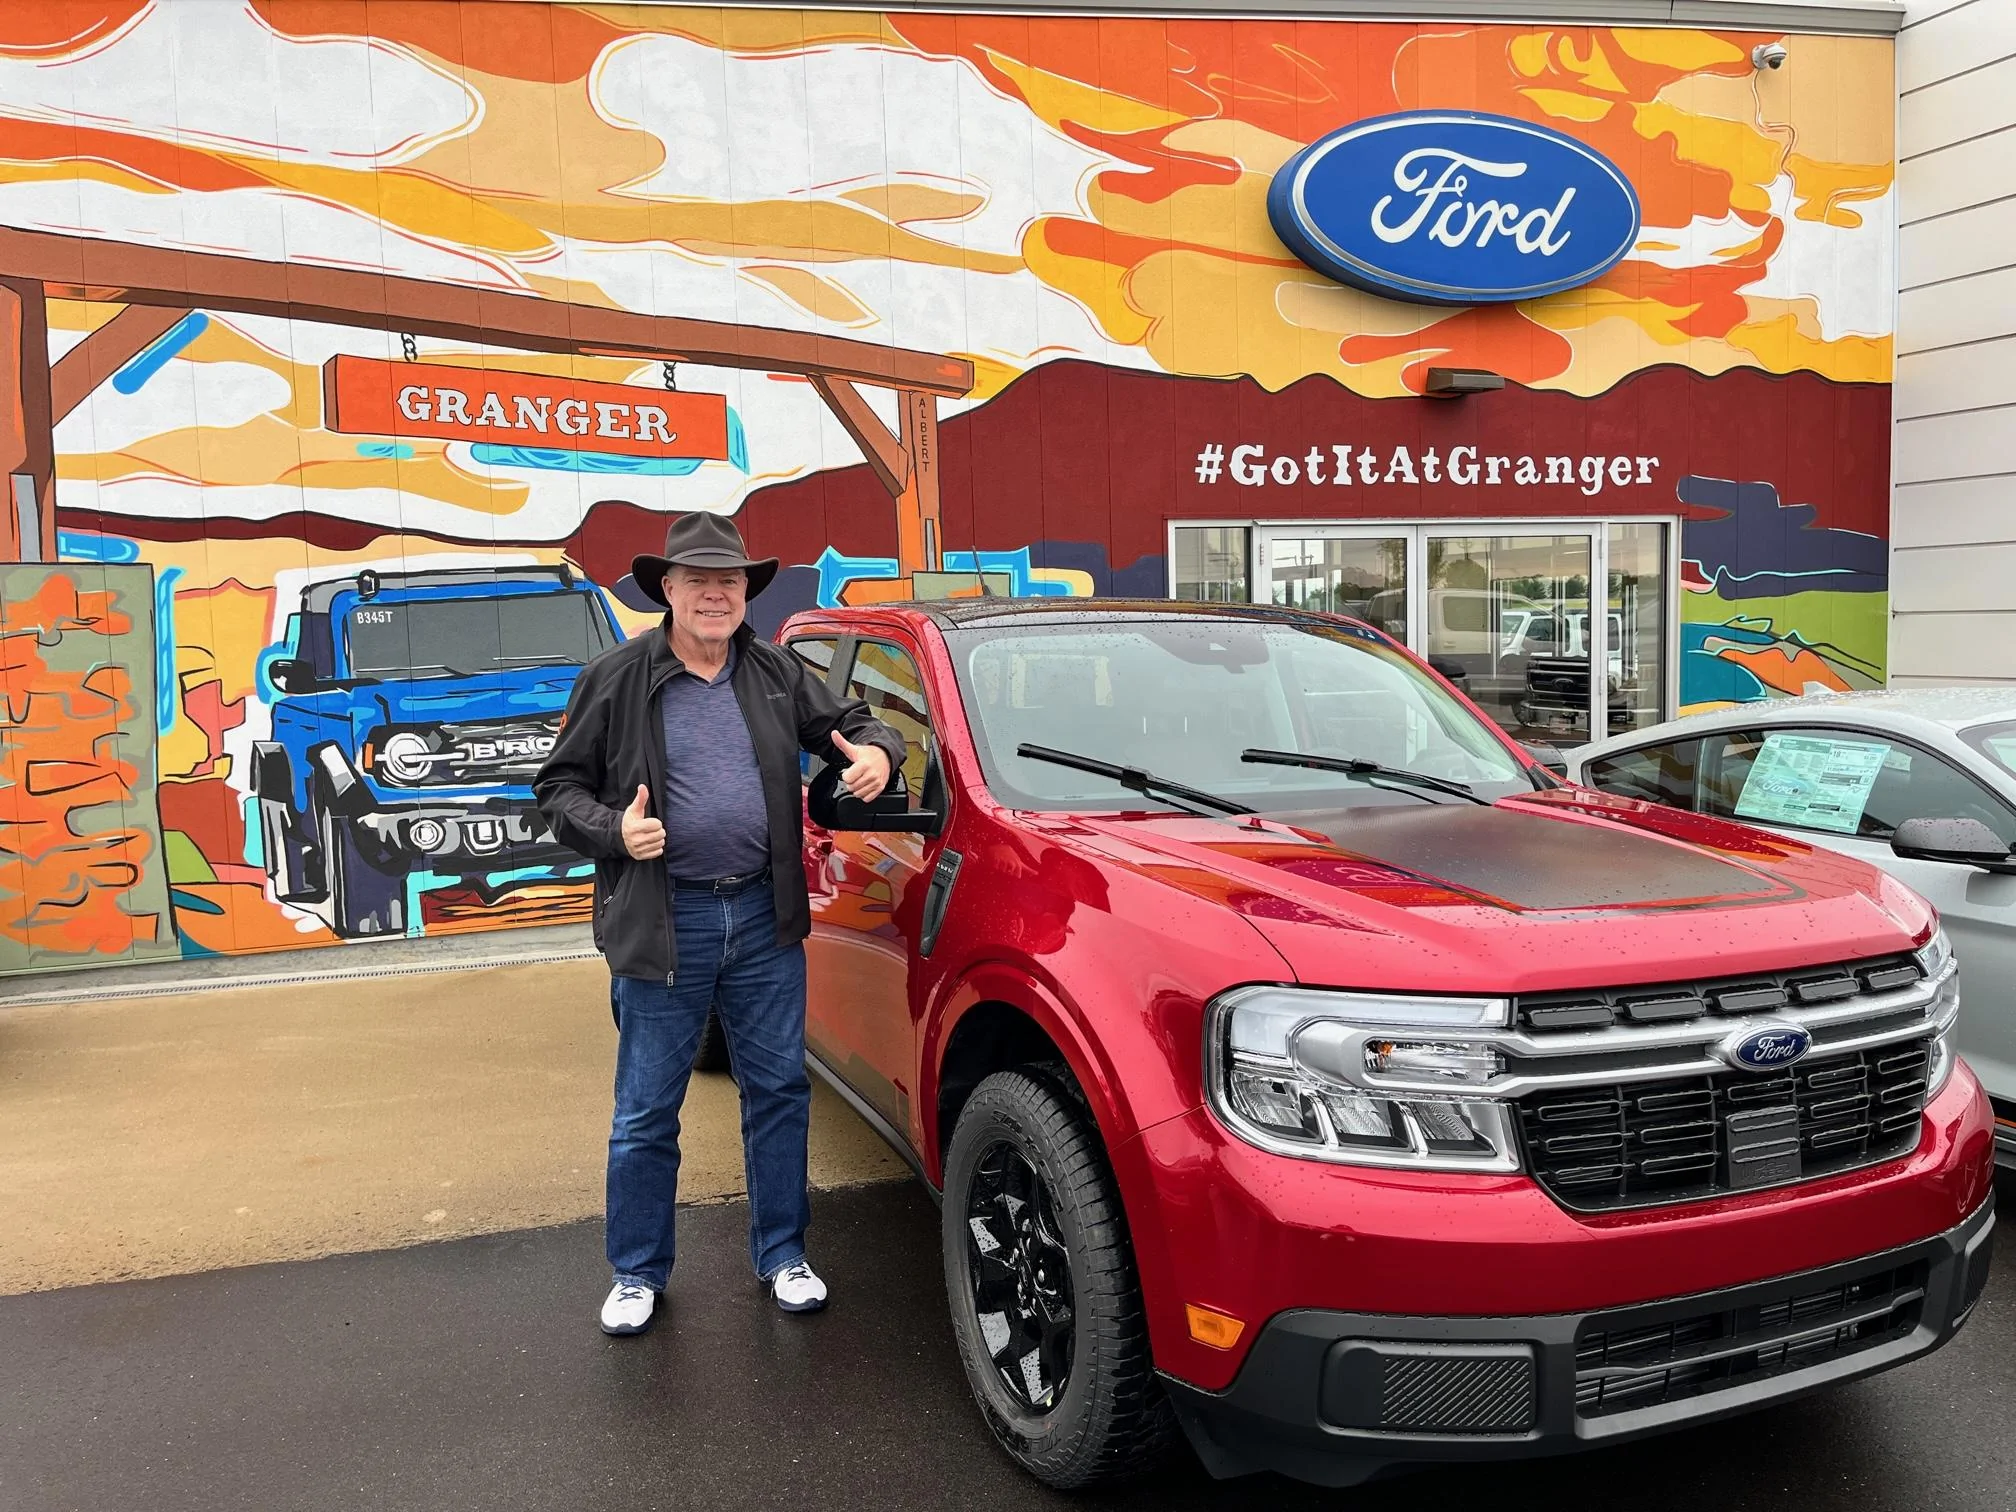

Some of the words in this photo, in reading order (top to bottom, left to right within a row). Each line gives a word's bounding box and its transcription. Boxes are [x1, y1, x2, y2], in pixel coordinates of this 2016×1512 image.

[1370, 147, 1577, 256] Ford
[397, 385, 678, 444] GRANGER
[918, 398, 930, 473] ALBERT
[1194, 443, 1660, 496] #GotItAtGranger
[356, 610, 394, 625] B345T
[1753, 1035, 1797, 1061] Ford
